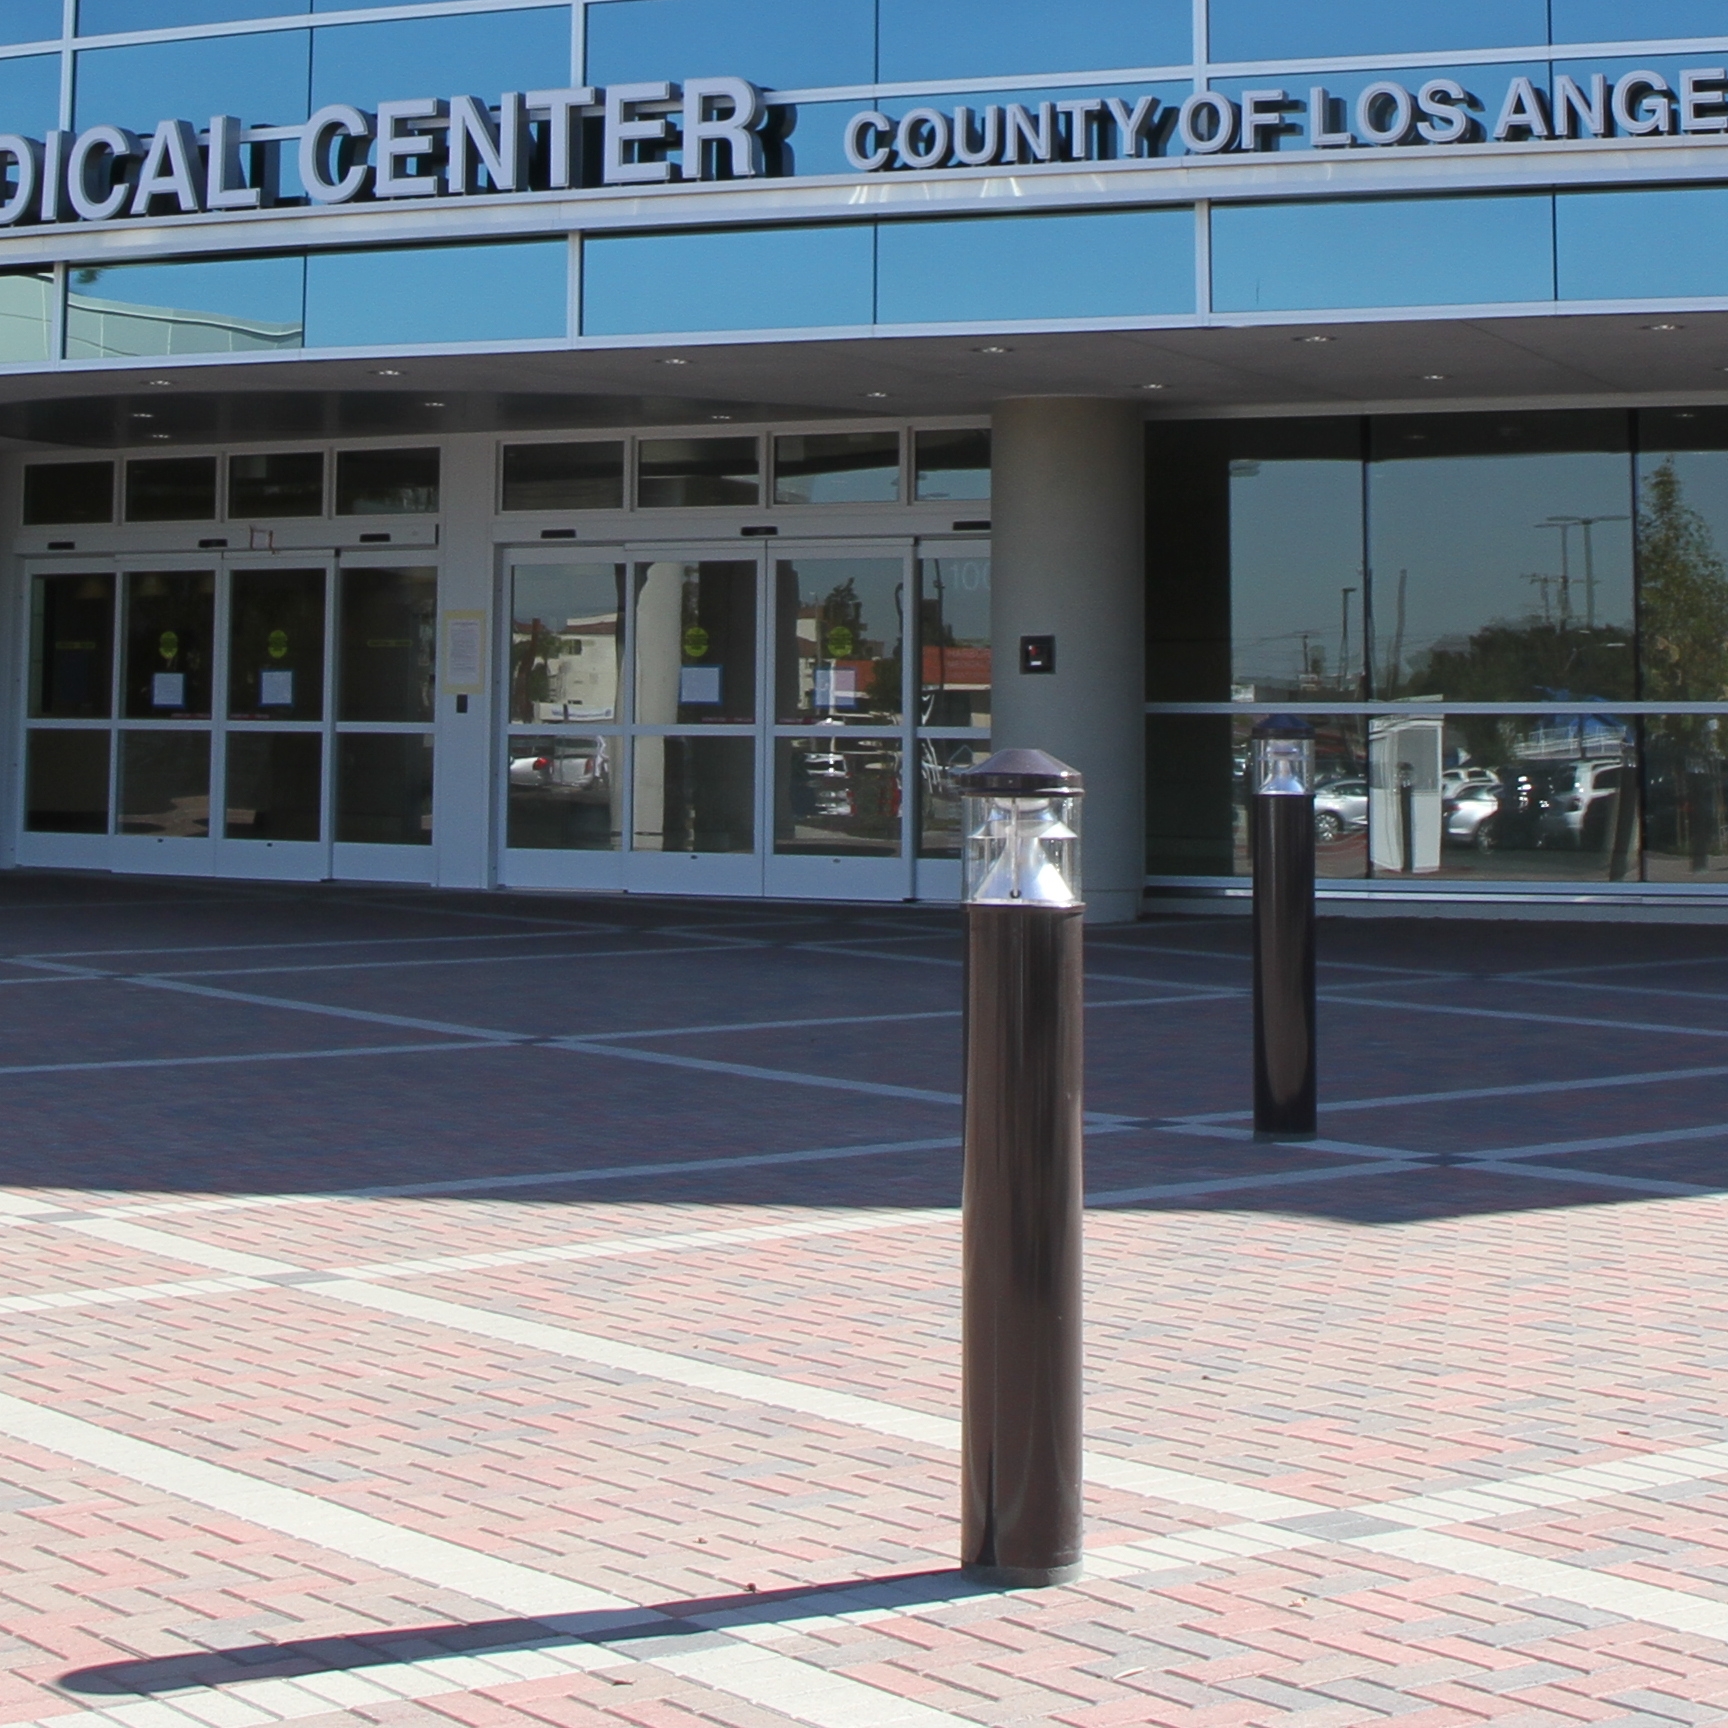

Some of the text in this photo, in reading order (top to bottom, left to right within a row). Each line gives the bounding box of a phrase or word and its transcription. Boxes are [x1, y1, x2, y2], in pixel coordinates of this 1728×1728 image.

[298, 76, 759, 203] CENTER
[843, 95, 1154, 171] COUNTY
[1178, 88, 1285, 154] OF
[1309, 78, 1468, 147] LOS
